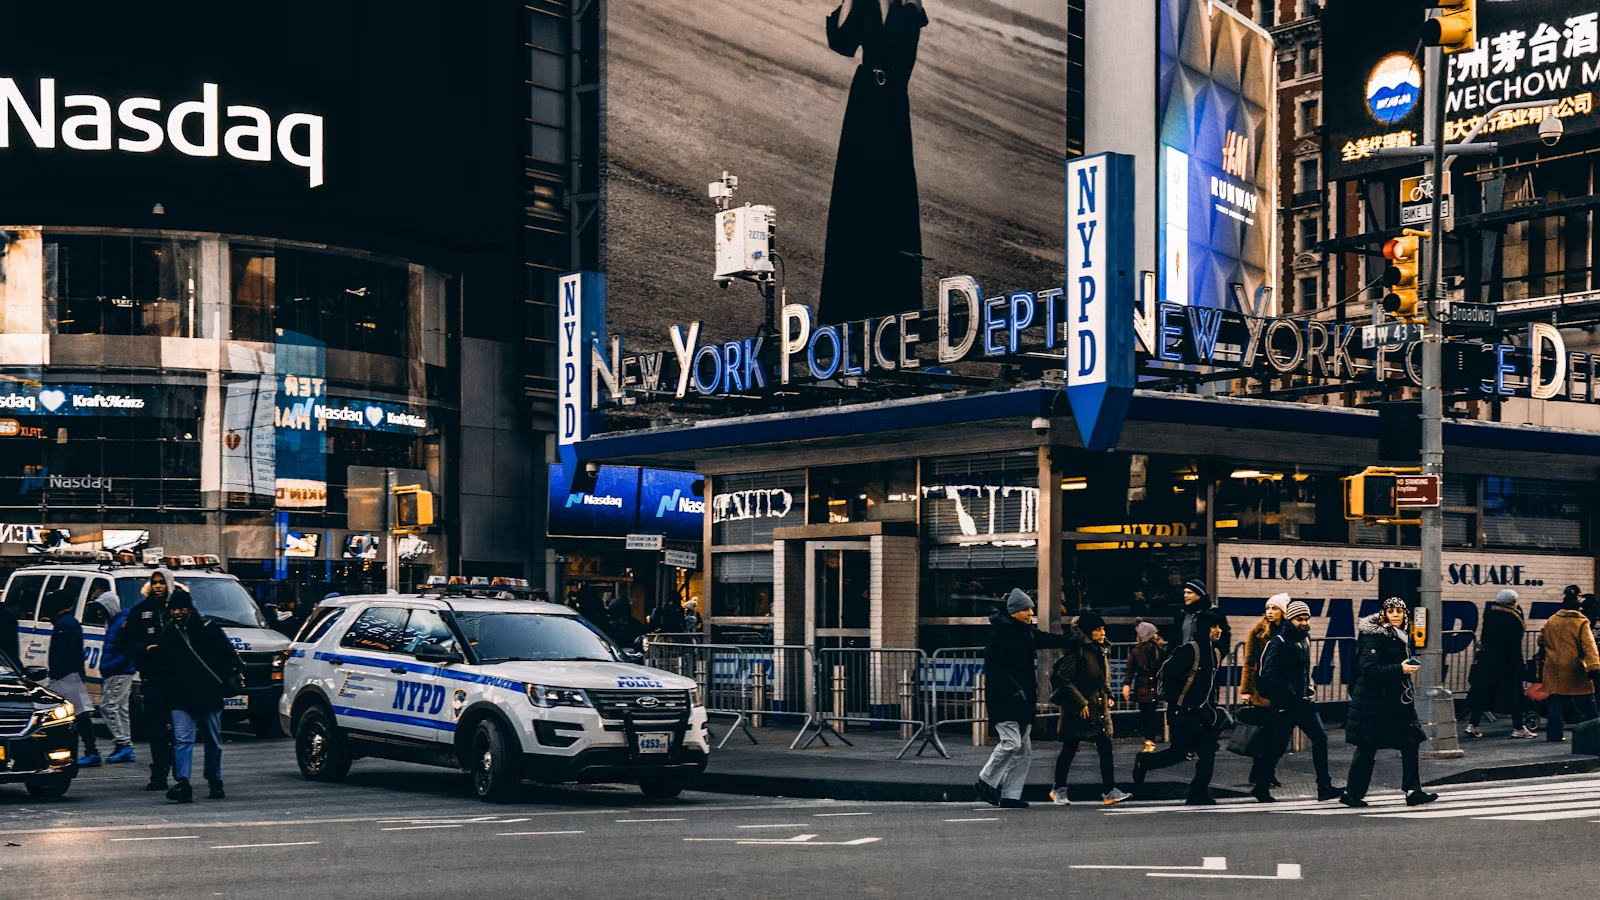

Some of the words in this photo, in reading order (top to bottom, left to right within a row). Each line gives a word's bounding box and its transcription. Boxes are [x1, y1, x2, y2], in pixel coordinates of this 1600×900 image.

[1447, 12, 1599, 86] 州茅台酒
[0, 77, 324, 188] Nasdaq
[1211, 176, 1258, 213] RUNWAY
[1404, 207, 1421, 220] BIKE
[1425, 202, 1447, 217] LE
[1077, 165, 1098, 378] NYPD
[1134, 271, 1224, 362] NEW
[1229, 282, 1357, 379] YORK
[1452, 304, 1495, 327] Broadway
[591, 334, 663, 410] NEW
[669, 320, 767, 400] YORK
[781, 302, 921, 385] POLICE
[938, 274, 1064, 364] DEPT
[1377, 326, 1389, 344] W
[1393, 323, 1408, 341] 43
[563, 280, 576, 438] NYPD
[314, 404, 363, 425] Nasdaq
[50, 474, 112, 492] Nasdaq
[584, 494, 622, 508] Nasdaq
[1121, 522, 1188, 549] NYPD
[1230, 556, 1343, 582] WELCOME
[1348, 559, 1375, 583] TO
[84, 646, 100, 670] PD
[486, 675, 513, 690] POLICE
[617, 680, 663, 688] POLICE
[392, 679, 446, 715] NYPD
[640, 738, 660, 749] 4253
